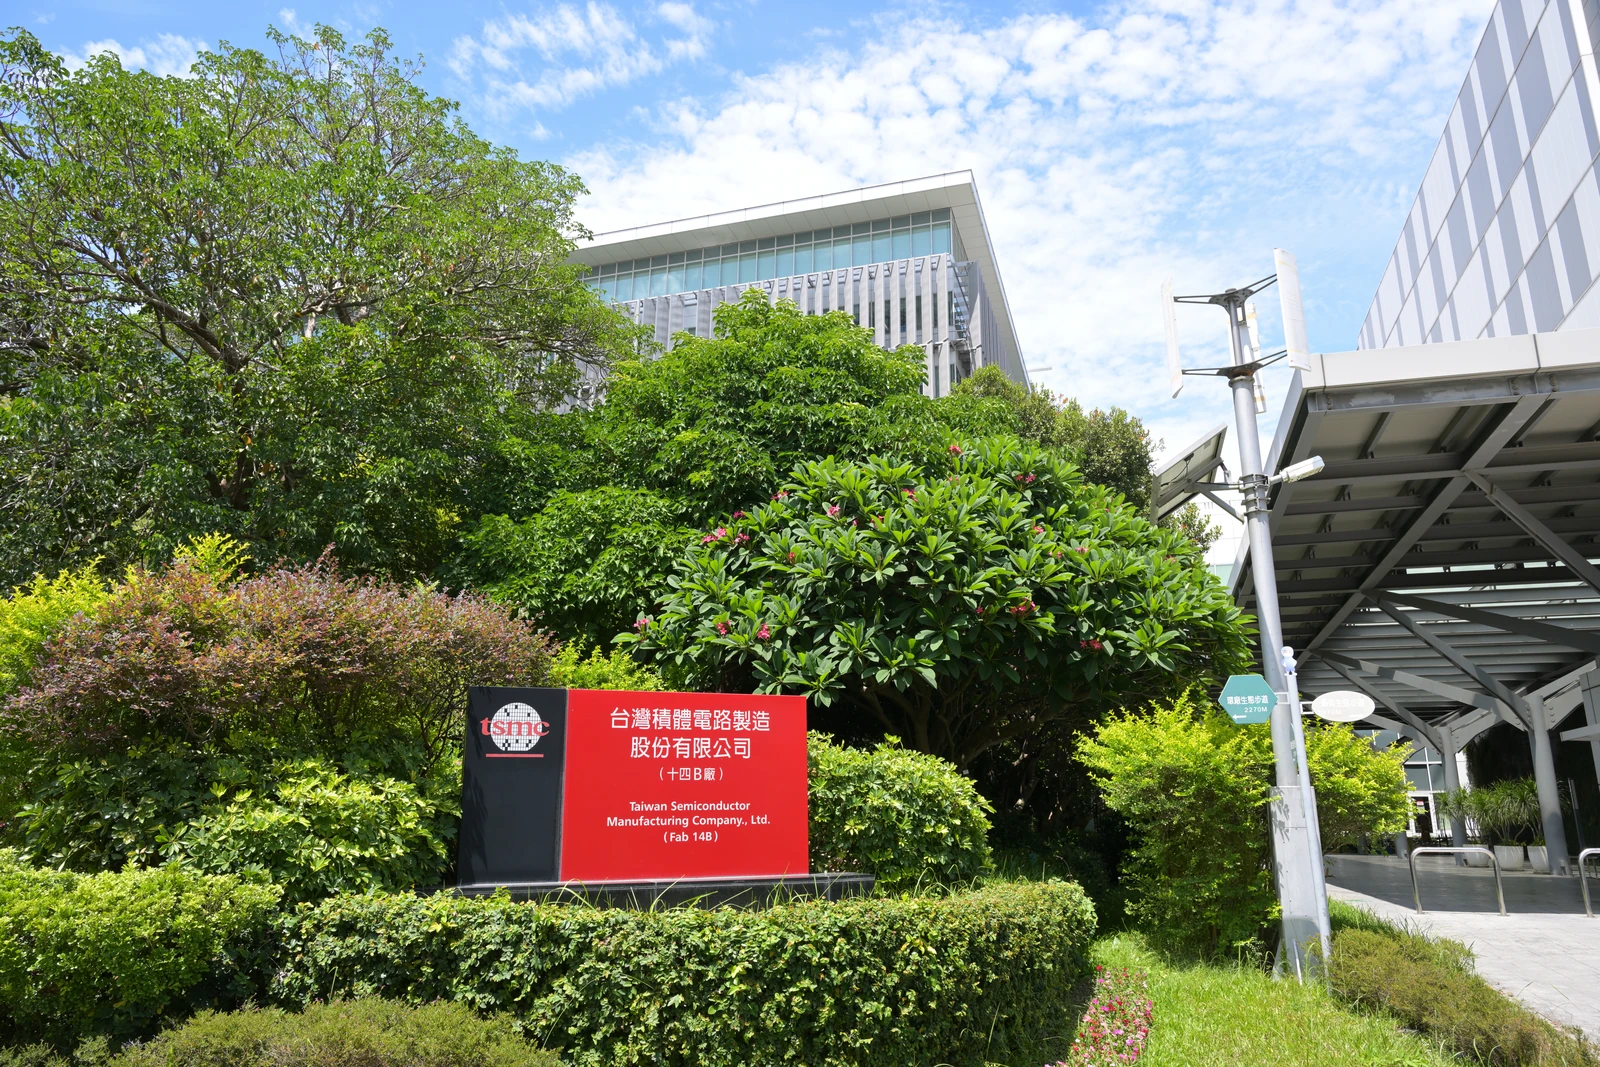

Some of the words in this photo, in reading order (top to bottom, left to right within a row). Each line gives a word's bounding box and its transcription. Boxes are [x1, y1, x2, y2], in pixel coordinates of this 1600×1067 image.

[480, 717, 550, 737] tsmc
[610, 707, 771, 732] 台灣積體電路製造
[630, 736, 751, 759] 股份有限公司
[629, 801, 668, 812] Taiwan
[670, 801, 751, 812] Semiconductor
[606, 816, 689, 828] Manufacturing
[691, 815, 748, 828] Company.,
[751, 815, 771, 825] Ltd.
[663, 831, 689, 843] (Fab
[692, 831, 719, 843] 14B)
